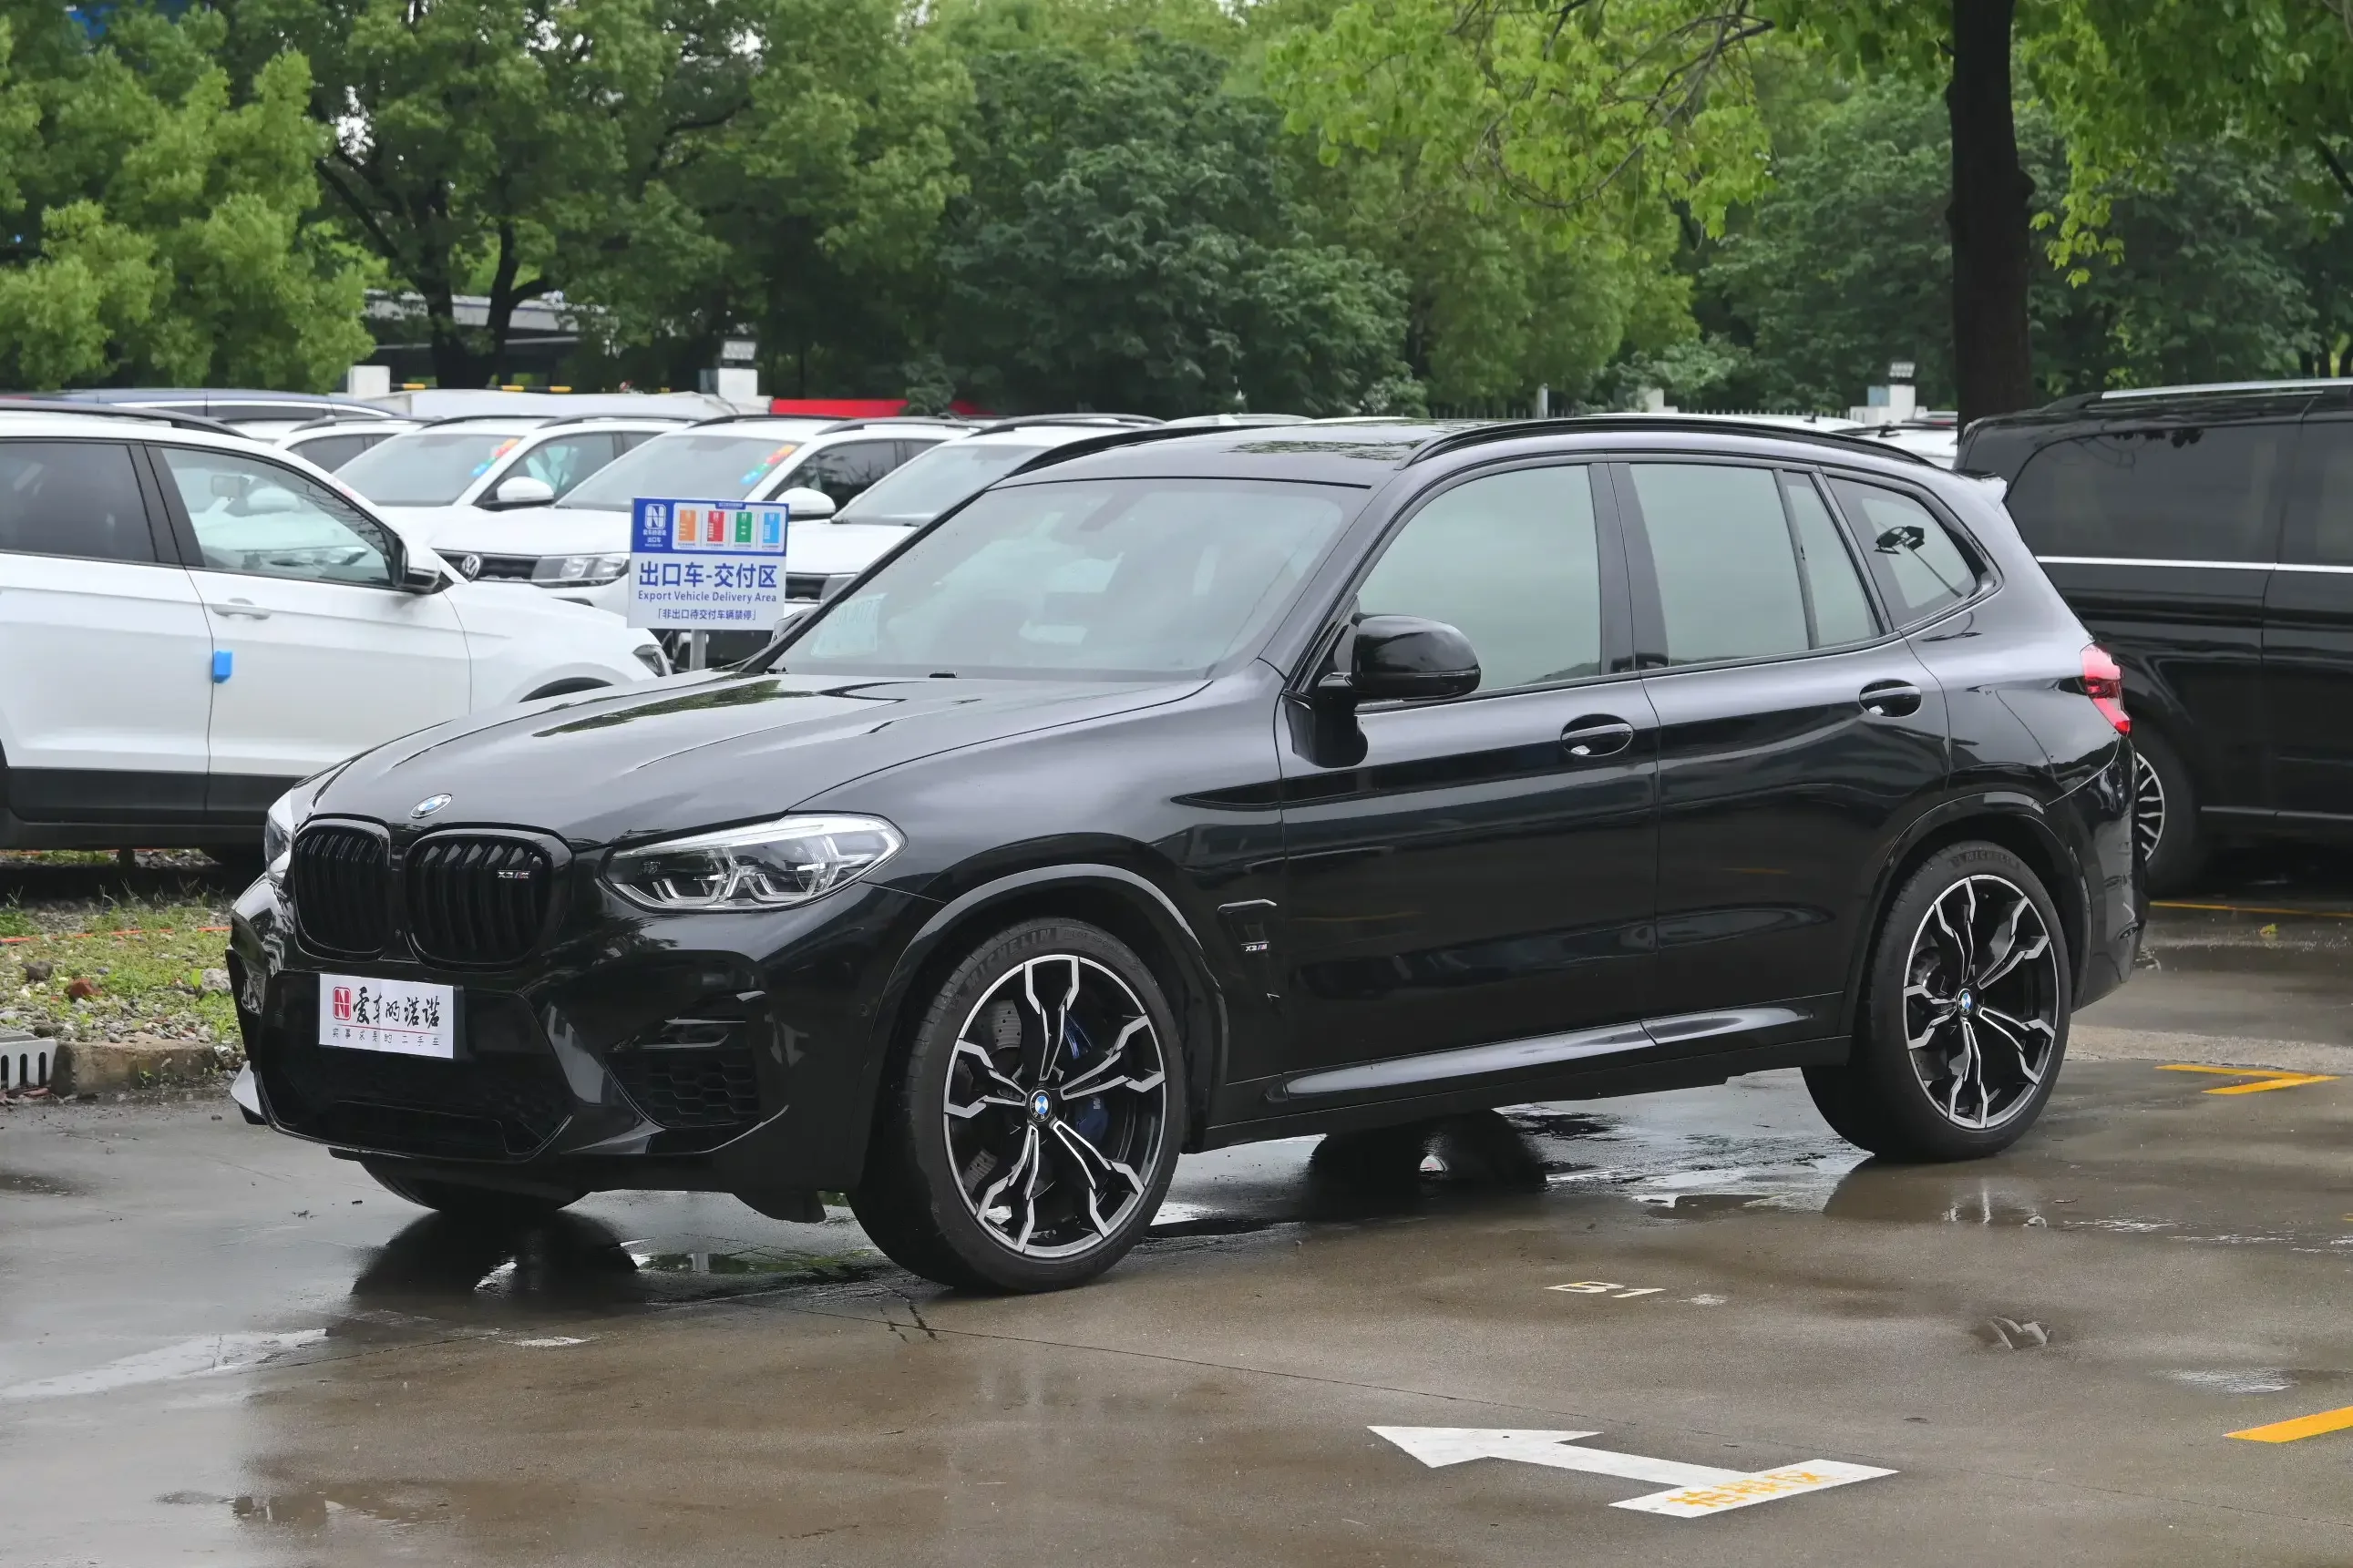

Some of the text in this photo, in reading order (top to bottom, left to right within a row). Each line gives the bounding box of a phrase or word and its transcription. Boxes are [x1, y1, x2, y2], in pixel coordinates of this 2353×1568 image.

[639, 561, 777, 588] 出口车-交付区
[638, 590, 776, 604] Export Vehicle Delivery Area
[965, 928, 1051, 990] MICHELIN
